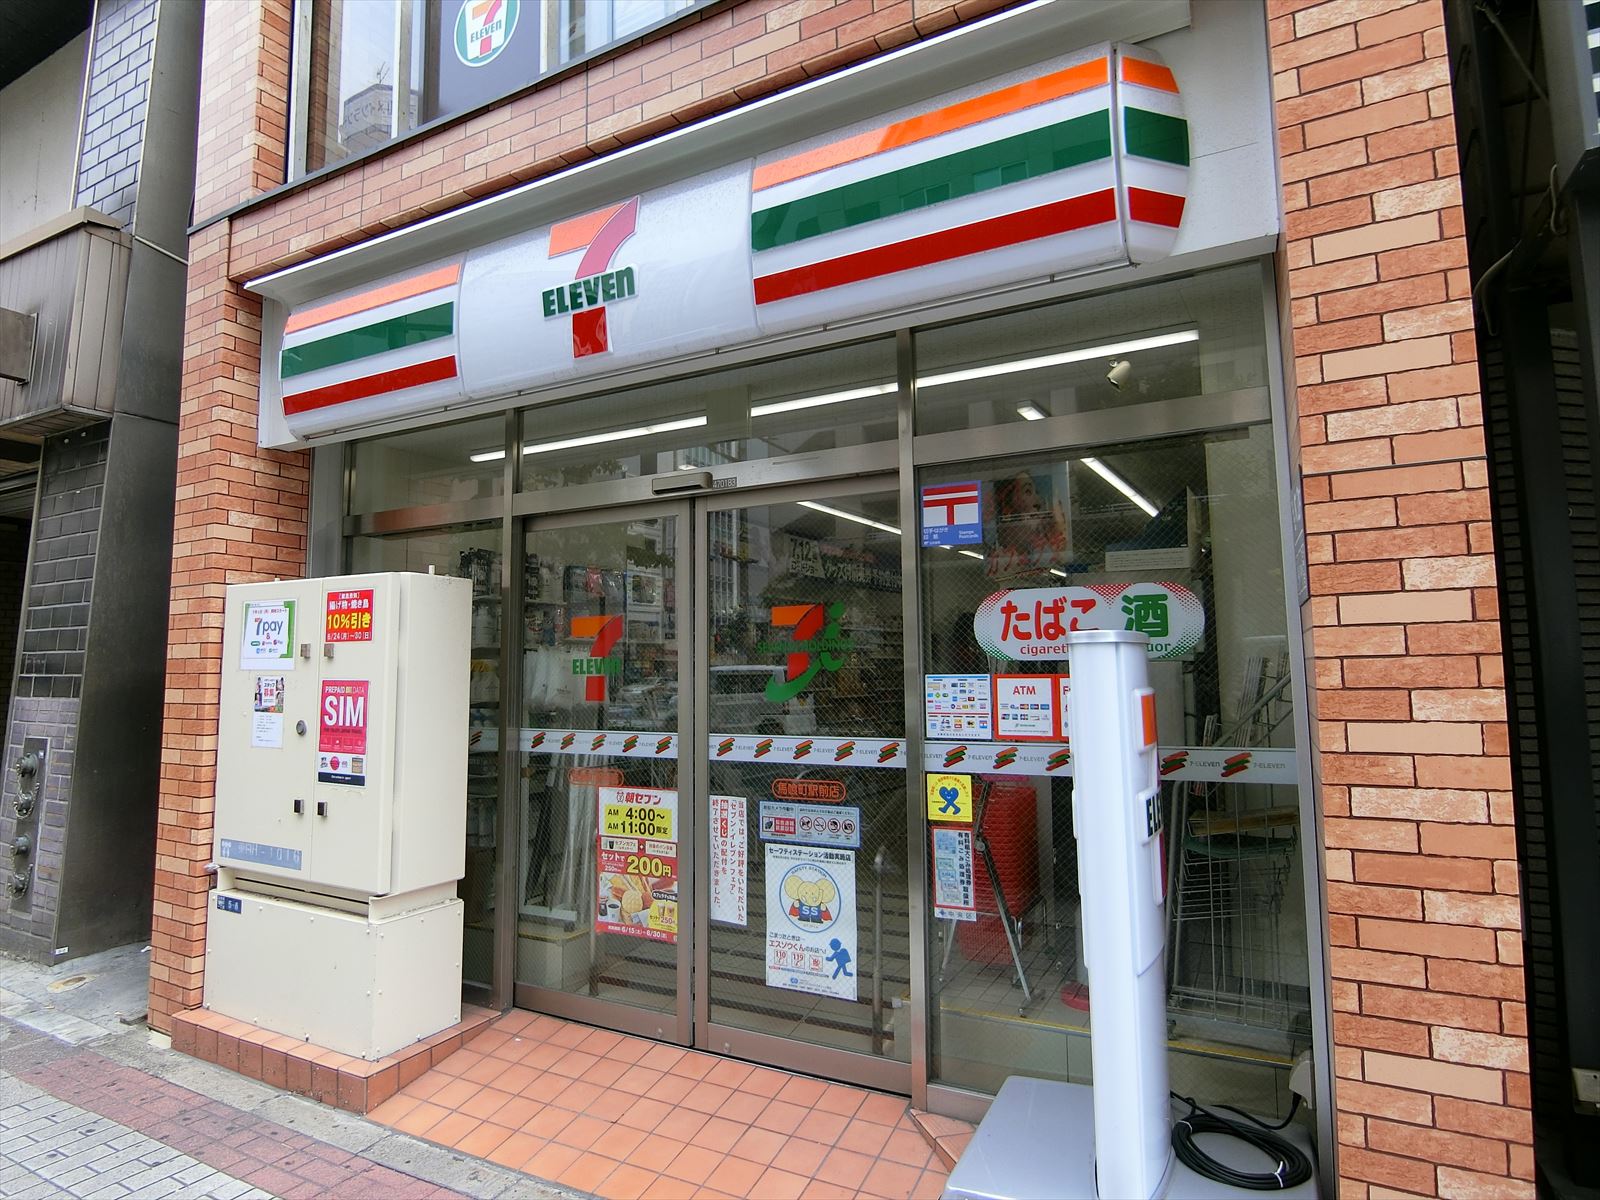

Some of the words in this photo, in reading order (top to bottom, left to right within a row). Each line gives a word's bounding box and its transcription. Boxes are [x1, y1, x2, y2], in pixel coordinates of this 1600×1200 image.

[327, 611, 372, 629] 10%引き
[1000, 595, 1100, 643] たばこ
[1120, 593, 1170, 638] 酒
[325, 685, 345, 693] PREPAID
[1012, 685, 1036, 695] ATM
[323, 695, 365, 728] SIM
[625, 792, 662, 805] 朝セブン
[608, 808, 619, 816] AM
[608, 822, 619, 830] AM
[626, 854, 673, 878] 200円
[802, 906, 819, 916] SS
